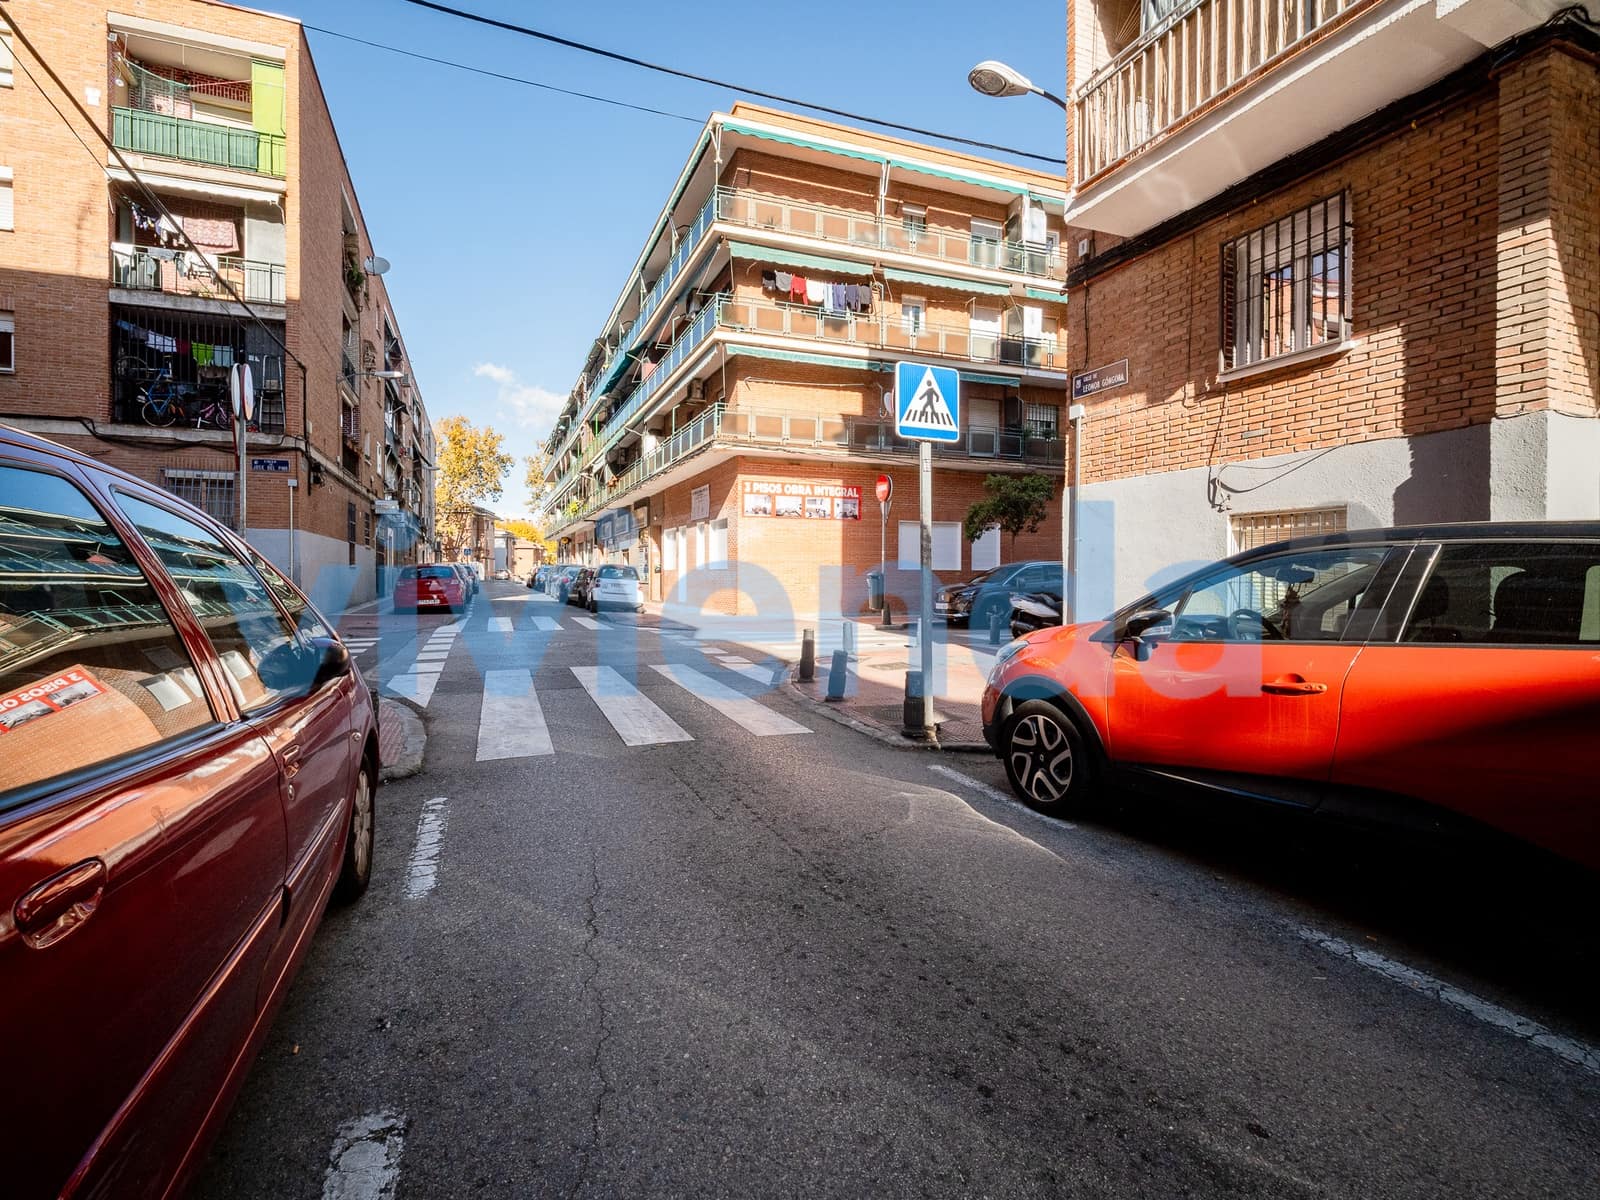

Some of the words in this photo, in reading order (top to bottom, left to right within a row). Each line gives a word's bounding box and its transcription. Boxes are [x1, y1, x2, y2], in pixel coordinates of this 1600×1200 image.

[1083, 381, 1101, 393] LEONOR
[1101, 373, 1125, 387] GÓNGORA
[744, 481, 751, 493] 3
[752, 481, 783, 494] PISOS
[784, 483, 813, 495] OBRA
[813, 486, 859, 498] INTEGRAL
